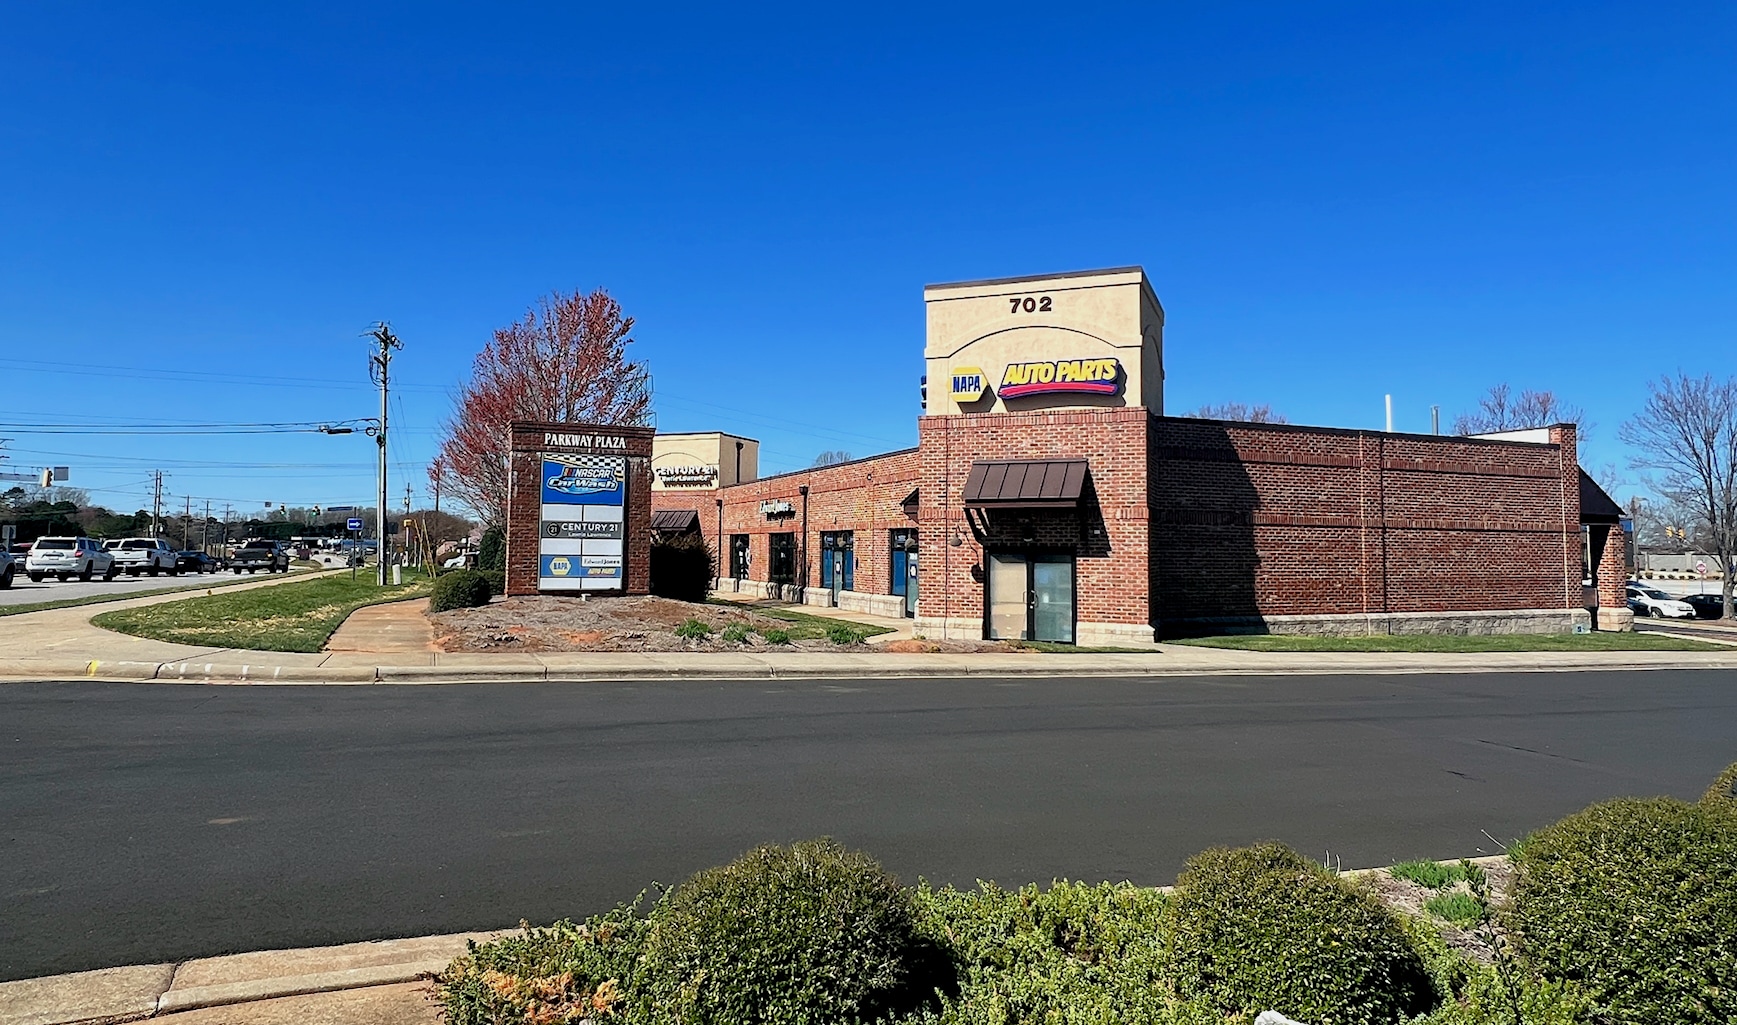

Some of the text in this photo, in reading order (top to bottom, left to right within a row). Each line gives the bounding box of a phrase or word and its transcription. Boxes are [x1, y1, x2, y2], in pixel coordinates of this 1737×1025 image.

[1009, 296, 1052, 314] 702
[1002, 359, 1117, 386] AUTO PARTS
[952, 375, 981, 393] NAPA
[544, 432, 627, 449] PARKWAY PLAZA
[574, 468, 611, 478] NASCAR
[655, 465, 714, 476] CENTURY 21
[561, 522, 618, 532] CENTURY 21
[553, 562, 568, 570] NAPA
